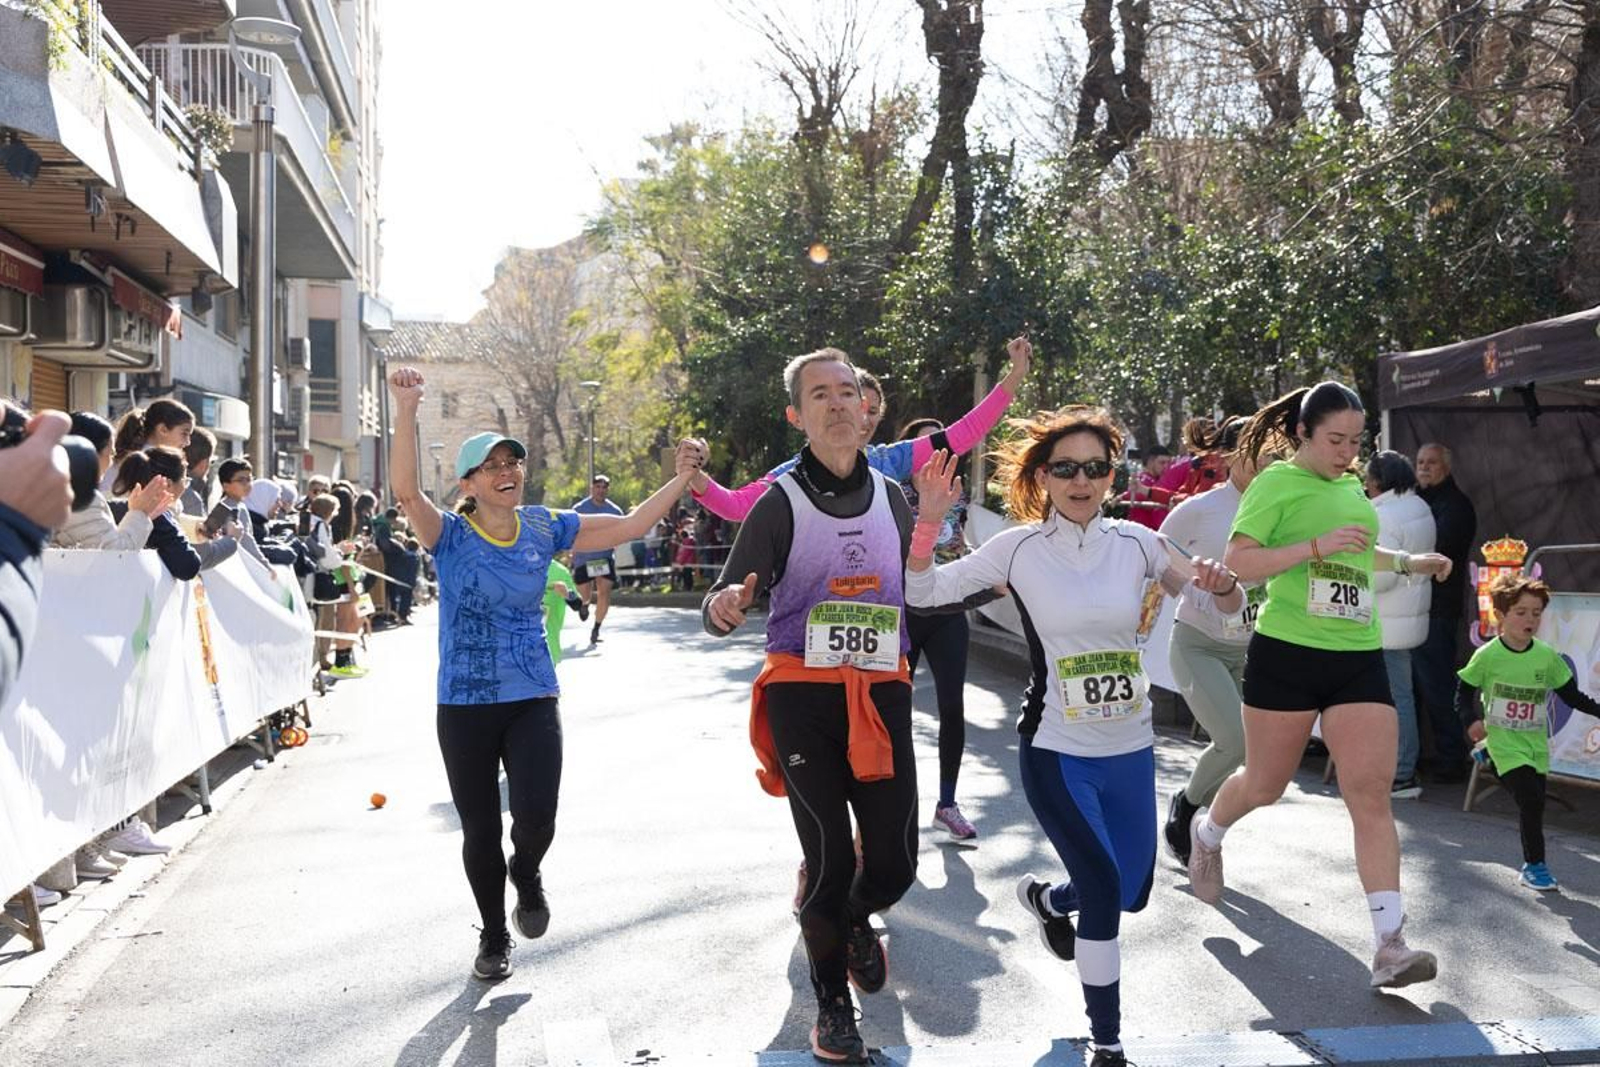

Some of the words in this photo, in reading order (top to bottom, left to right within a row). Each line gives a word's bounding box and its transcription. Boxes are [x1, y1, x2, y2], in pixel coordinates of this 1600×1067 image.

[1330, 581, 1359, 607] 218
[826, 604, 837, 613] SAN
[839, 604, 854, 613] JUAN
[828, 625, 879, 654] 586
[1074, 654, 1086, 664] SAN
[1083, 674, 1134, 705] 823
[1505, 701, 1536, 720] 931
